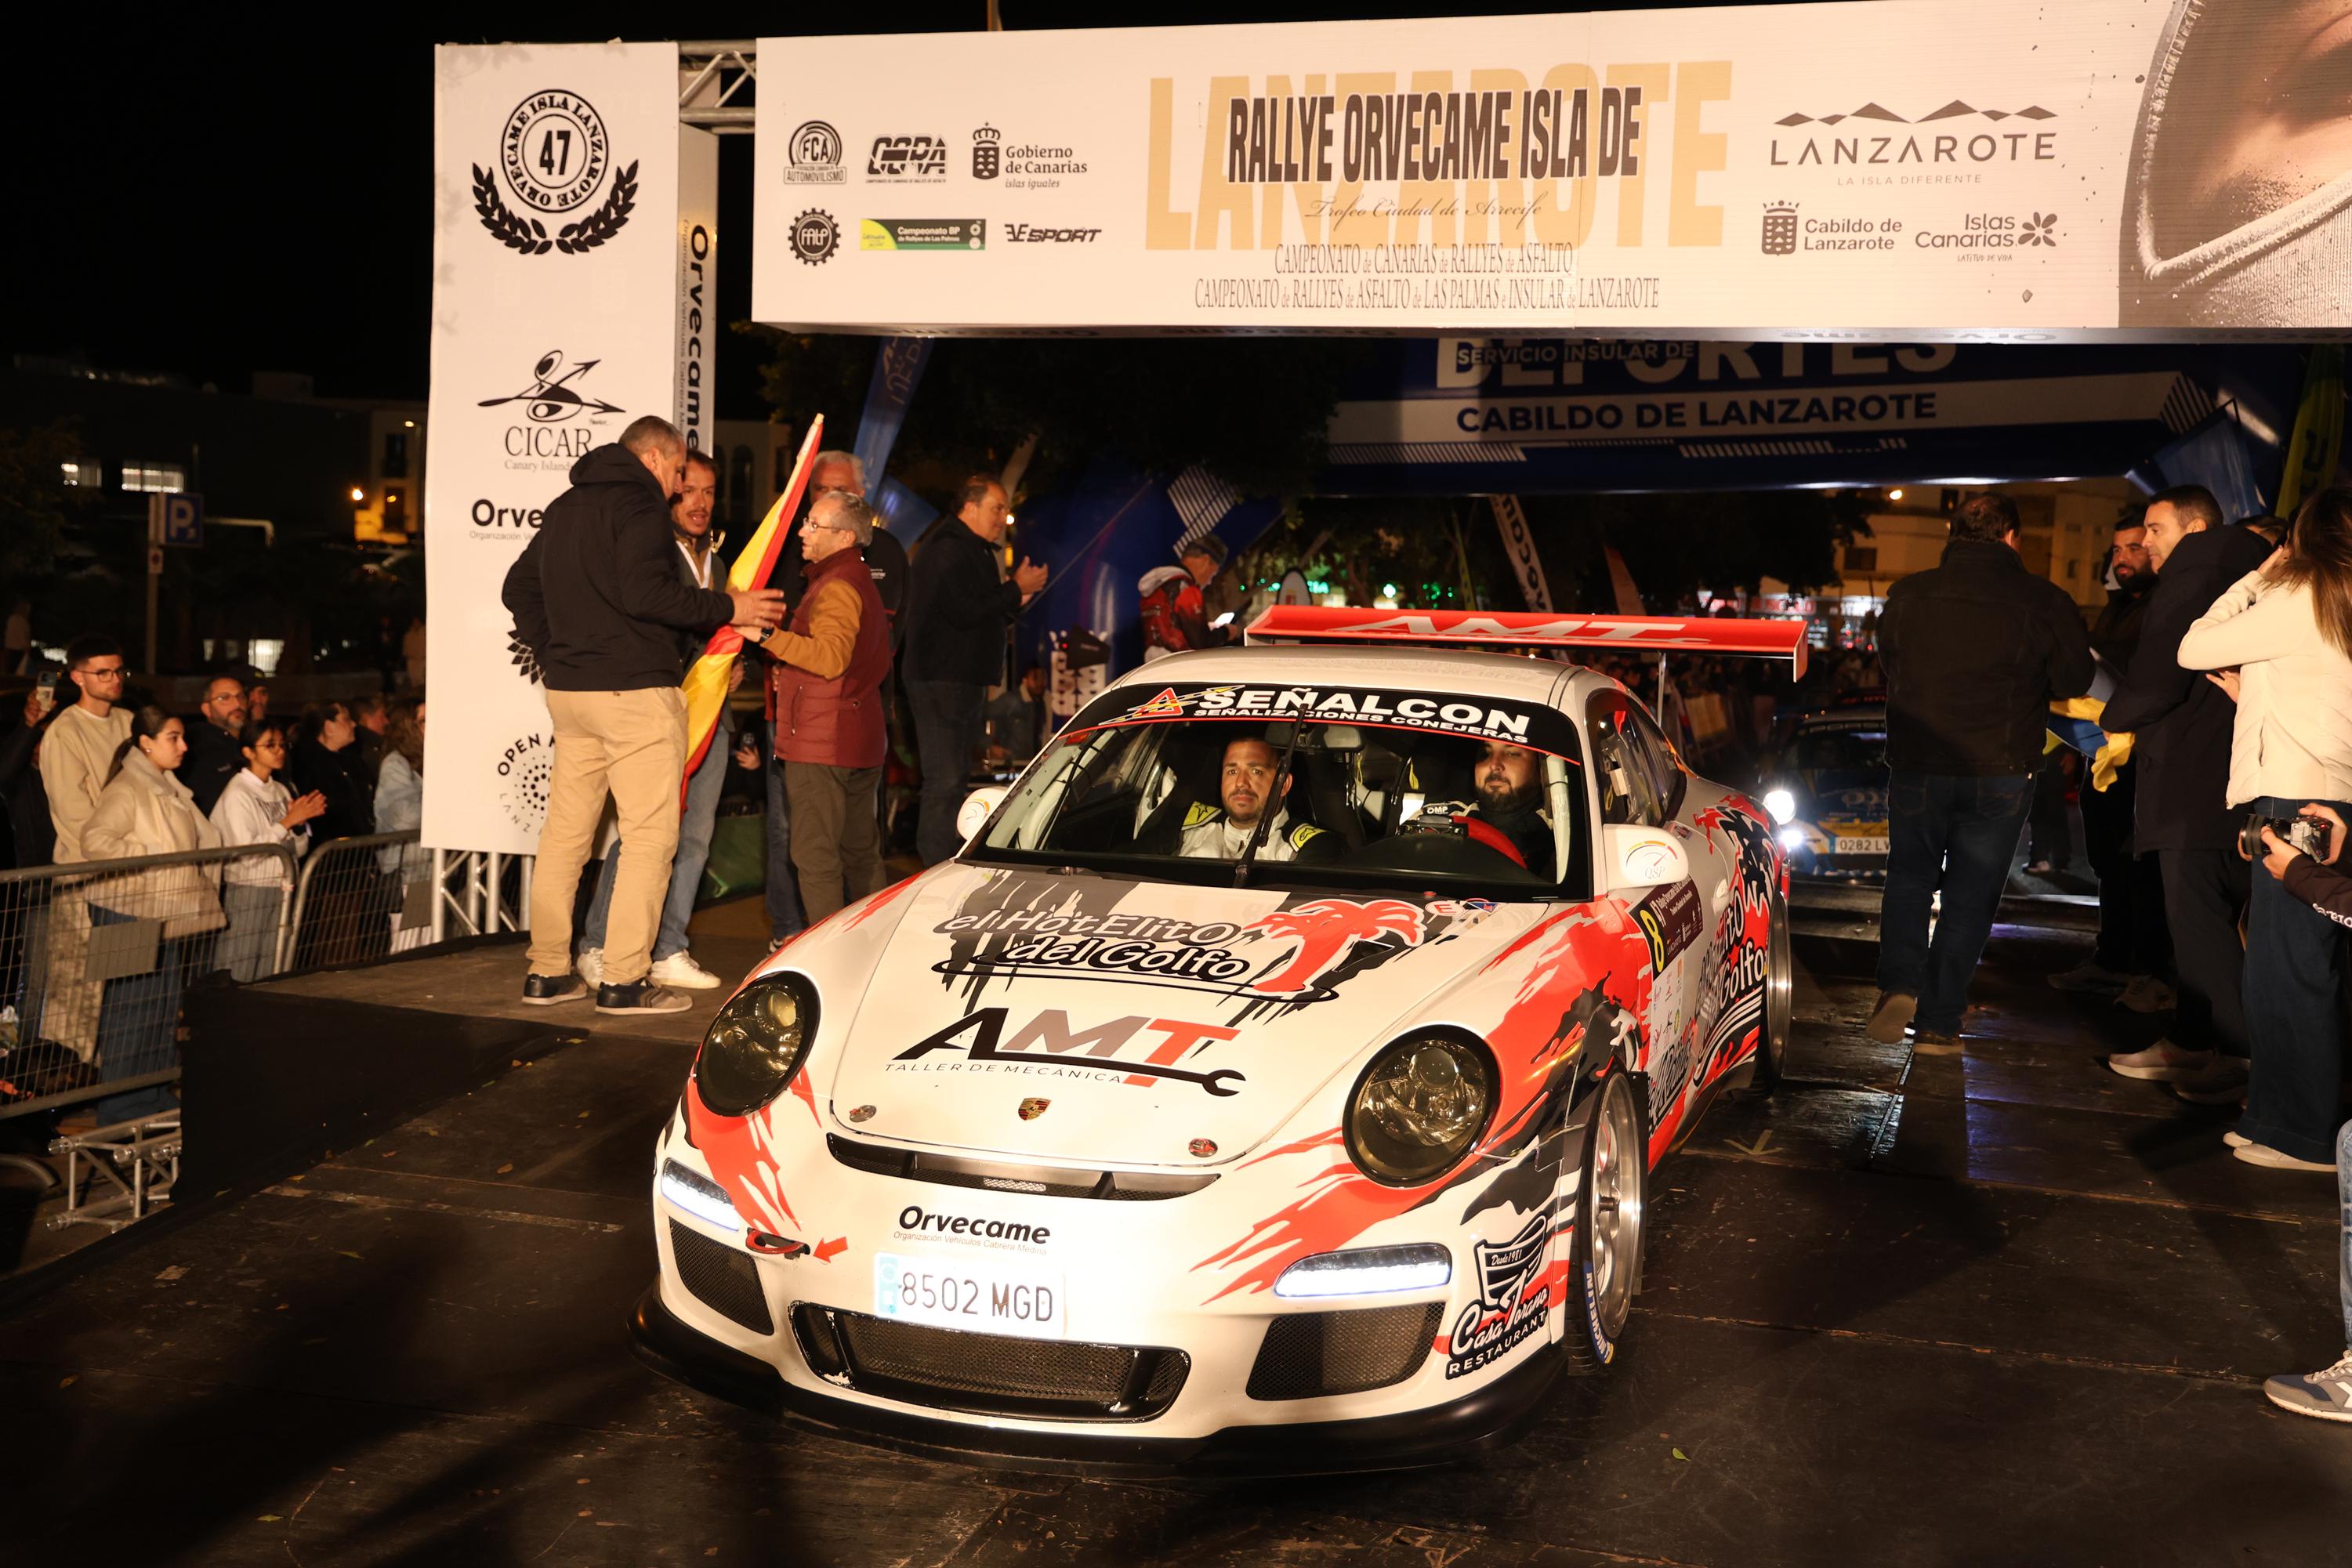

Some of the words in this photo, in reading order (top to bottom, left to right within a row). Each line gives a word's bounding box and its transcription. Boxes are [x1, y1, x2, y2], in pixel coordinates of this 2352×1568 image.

[803, 137, 828, 161] FCA
[1228, 96, 1334, 183] RALLYE
[1343, 91, 1512, 182] ORVECAME
[1520, 88, 1588, 179] ISLA
[1598, 86, 1642, 176] DE
[1770, 132, 2057, 165] LANZAROTE
[539, 130, 571, 176] 47
[1006, 145, 1073, 158] Gobierno
[1006, 161, 1022, 173] de
[1024, 161, 1088, 173] Canarias
[1005, 179, 1025, 188] islas
[1027, 179, 1060, 190] iguales
[1837, 177, 1855, 186] LA
[1861, 176, 1894, 185] ISLA
[1901, 174, 1983, 185] DIFERENTE
[1304, 194, 1367, 231] Trofeo
[1372, 197, 1443, 218] Ciudad
[1439, 197, 1460, 217] de
[1465, 191, 1549, 230] Arrecife
[1805, 219, 1874, 234] Cabildo
[1880, 218, 1903, 233] de
[1965, 213, 2016, 231] Islas
[897, 226, 948, 235] Campeonato
[948, 226, 961, 234] BP
[1804, 237, 1895, 251] Lanzarote
[1915, 230, 2014, 249] Canarias
[1274, 244, 1361, 274] CAMPEONATO
[1363, 251, 1372, 273] de
[1374, 243, 1437, 274] CANARIAS
[1439, 250, 1449, 273] de
[1450, 242, 1504, 274] RALLYES
[1516, 242, 1573, 273] ASFALTO
[1998, 253, 2013, 263] VIDA
[1195, 278, 1280, 309] CAMPEONATO
[1281, 286, 1291, 309] de
[1292, 278, 1344, 309] RALLYES
[1345, 286, 1355, 309] de
[1356, 278, 1411, 309] ASFALTO
[1412, 286, 1422, 309] de
[1424, 278, 1448, 309] LAS
[1450, 278, 1500, 309] PALMAS
[1508, 278, 1566, 309] INSULAR
[1578, 277, 1660, 309] LANZAROTE
[687, 224, 708, 452] Orvecame
[1457, 346, 1557, 366] SERVICIO
[1564, 342, 1660, 363] INSULAR
[1665, 341, 1696, 360] DE
[1457, 404, 1624, 433] CABILDO
[1636, 402, 1687, 429] DE
[1699, 393, 1938, 428] LANZAROTE
[505, 426, 592, 457] CICAR
[505, 460, 538, 473] Canary
[542, 460, 573, 472] Island
[170, 502, 196, 539] P
[472, 499, 544, 528] Orve
[1198, 686, 1531, 735] SEÑALCON
[1390, 716, 1529, 744] CONEJERAS
[498, 733, 542, 777] OPEN
[1426, 806, 1448, 815] OMP
[1839, 839, 1872, 851] 0282
[1644, 865, 1666, 880] QSP
[1640, 909, 1665, 973] 8
[1005, 940, 1094, 965] del
[1100, 940, 1250, 979] Golfo
[1720, 940, 1764, 1010] Golfo
[891, 1007, 1242, 1088] AMT
[885, 1063, 962, 1073] TALLER
[970, 1063, 997, 1072] DE
[1004, 1065, 1122, 1084] MECÁNICA
[899, 1205, 1050, 1244] Orvecame
[893, 1230, 942, 1244] Organización
[944, 1234, 981, 1248] Vehículos
[983, 1240, 1016, 1252] Cabrera
[1017, 1244, 1047, 1256] Medina
[901, 1271, 980, 1316] 8502
[991, 1281, 1053, 1323] MGD
[1451, 1302, 1503, 1357] Casa
[1586, 1272, 1611, 1360] MICHELIN
[1448, 1309, 1547, 1375] RESTAURANT
